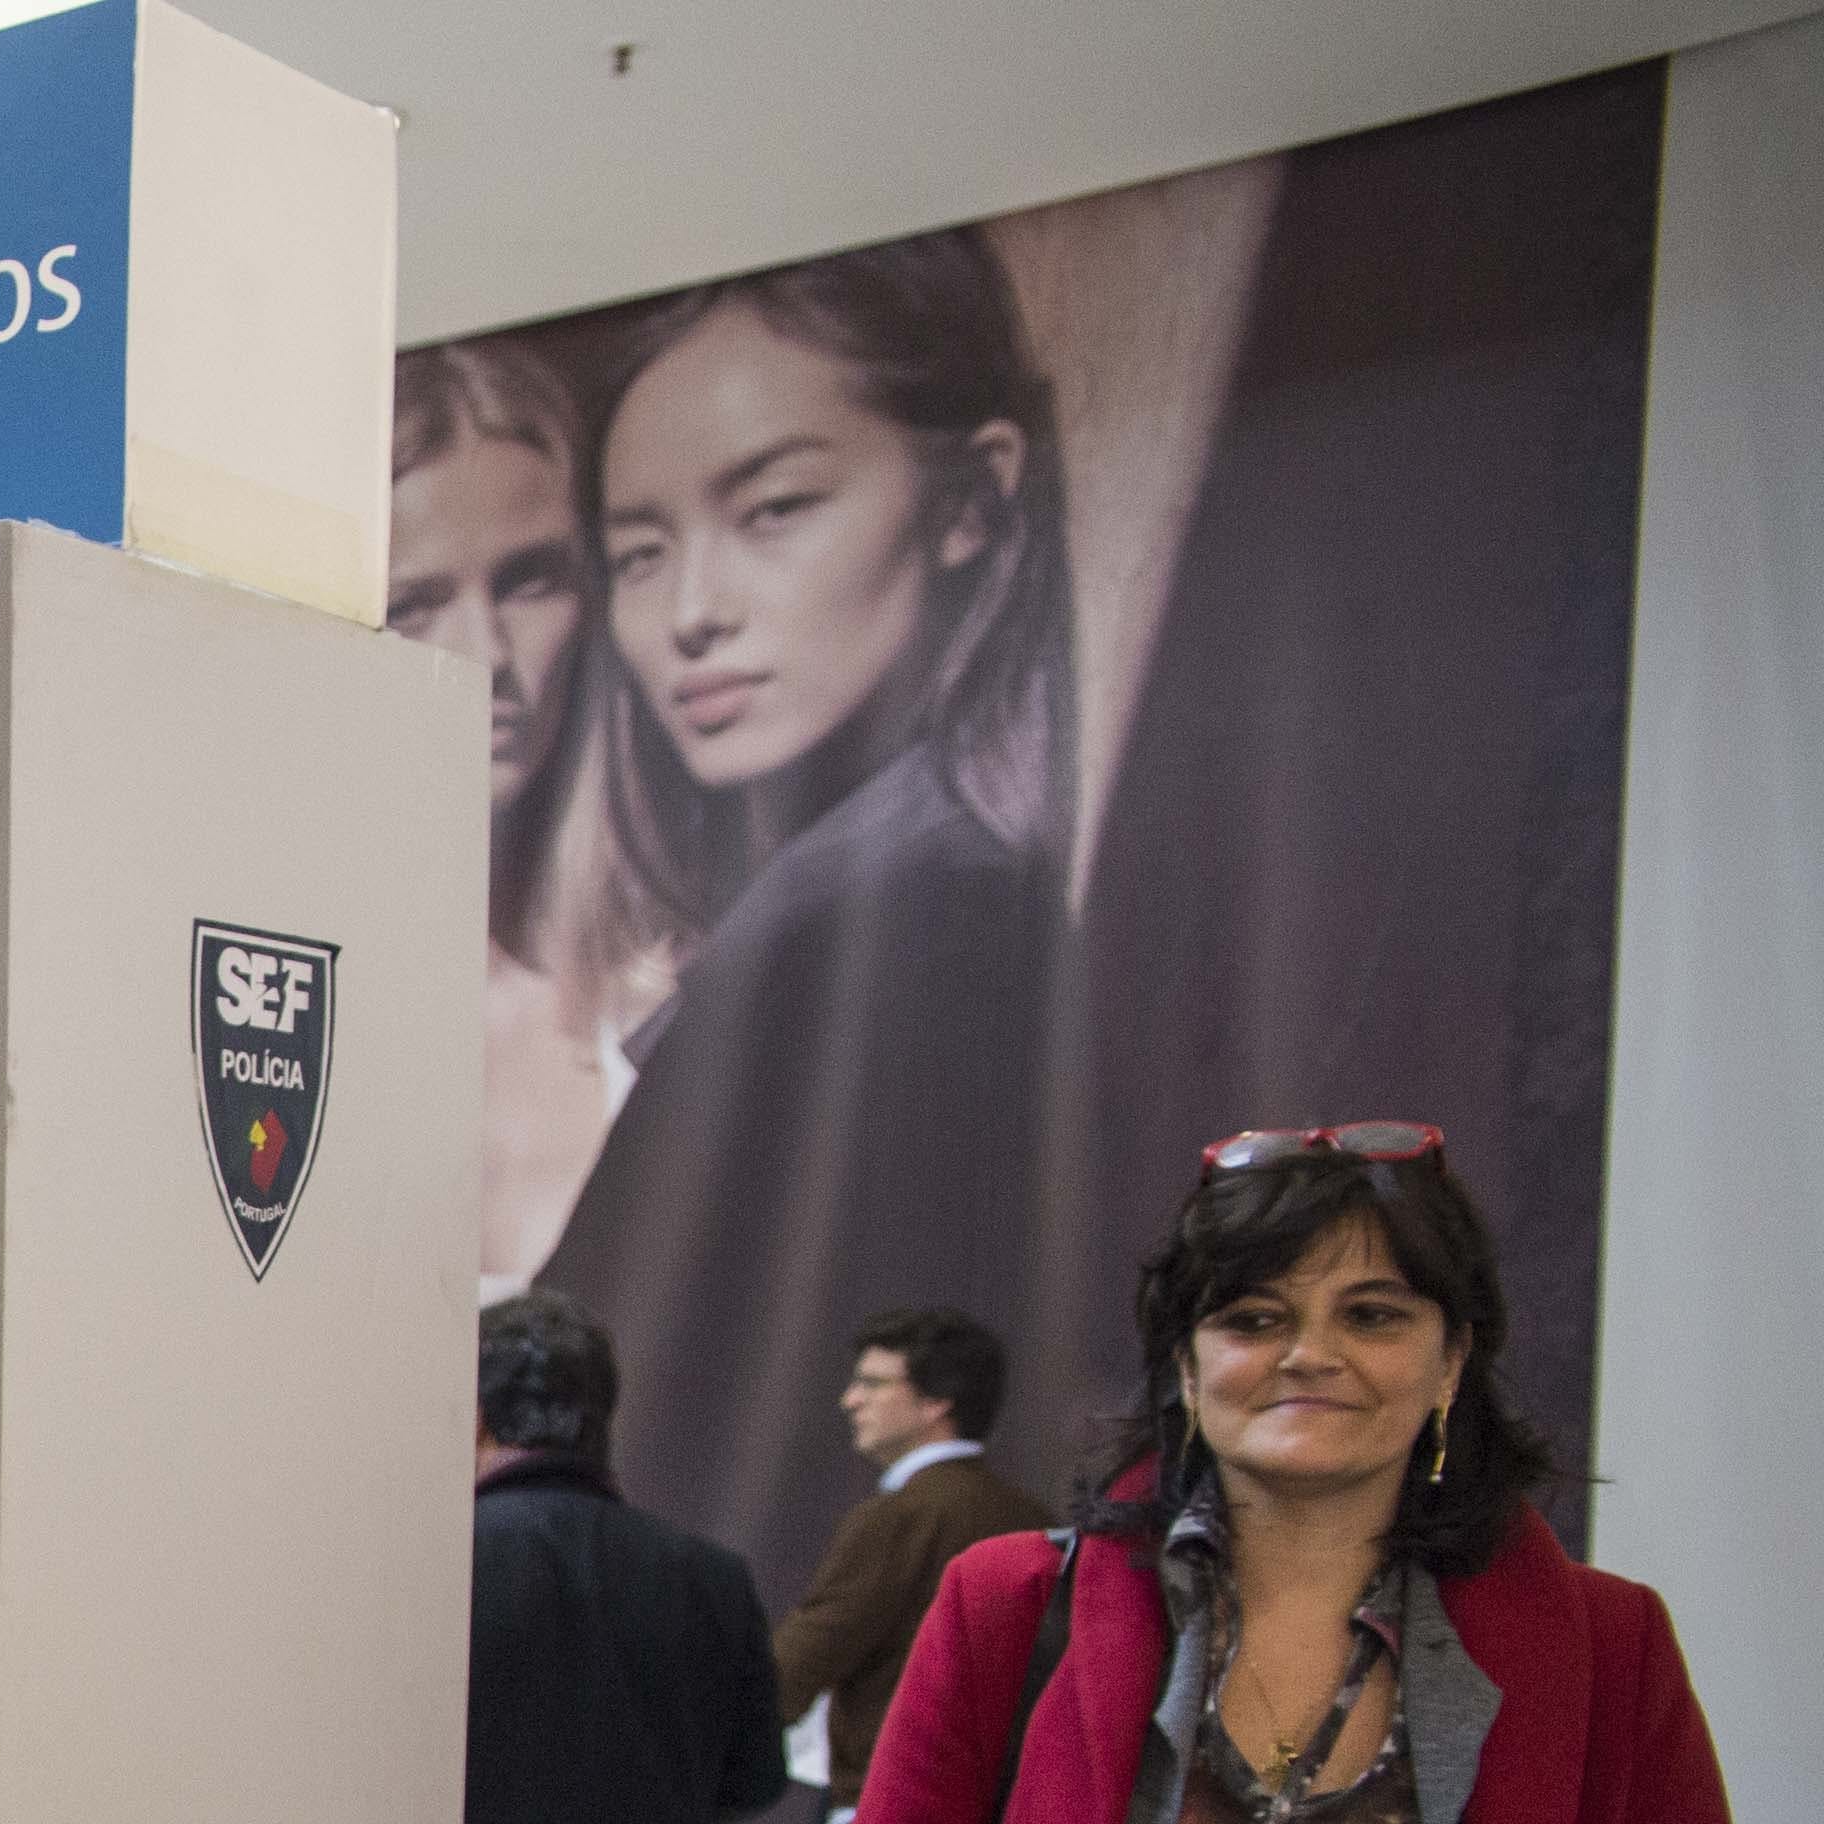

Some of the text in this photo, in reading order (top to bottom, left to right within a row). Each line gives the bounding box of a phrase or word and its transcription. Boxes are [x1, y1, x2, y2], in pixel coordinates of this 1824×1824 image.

[216, 946, 314, 1034] SEF
[220, 1049, 306, 1091] POLÍCIA
[233, 1195, 288, 1223] PORTUGAL
